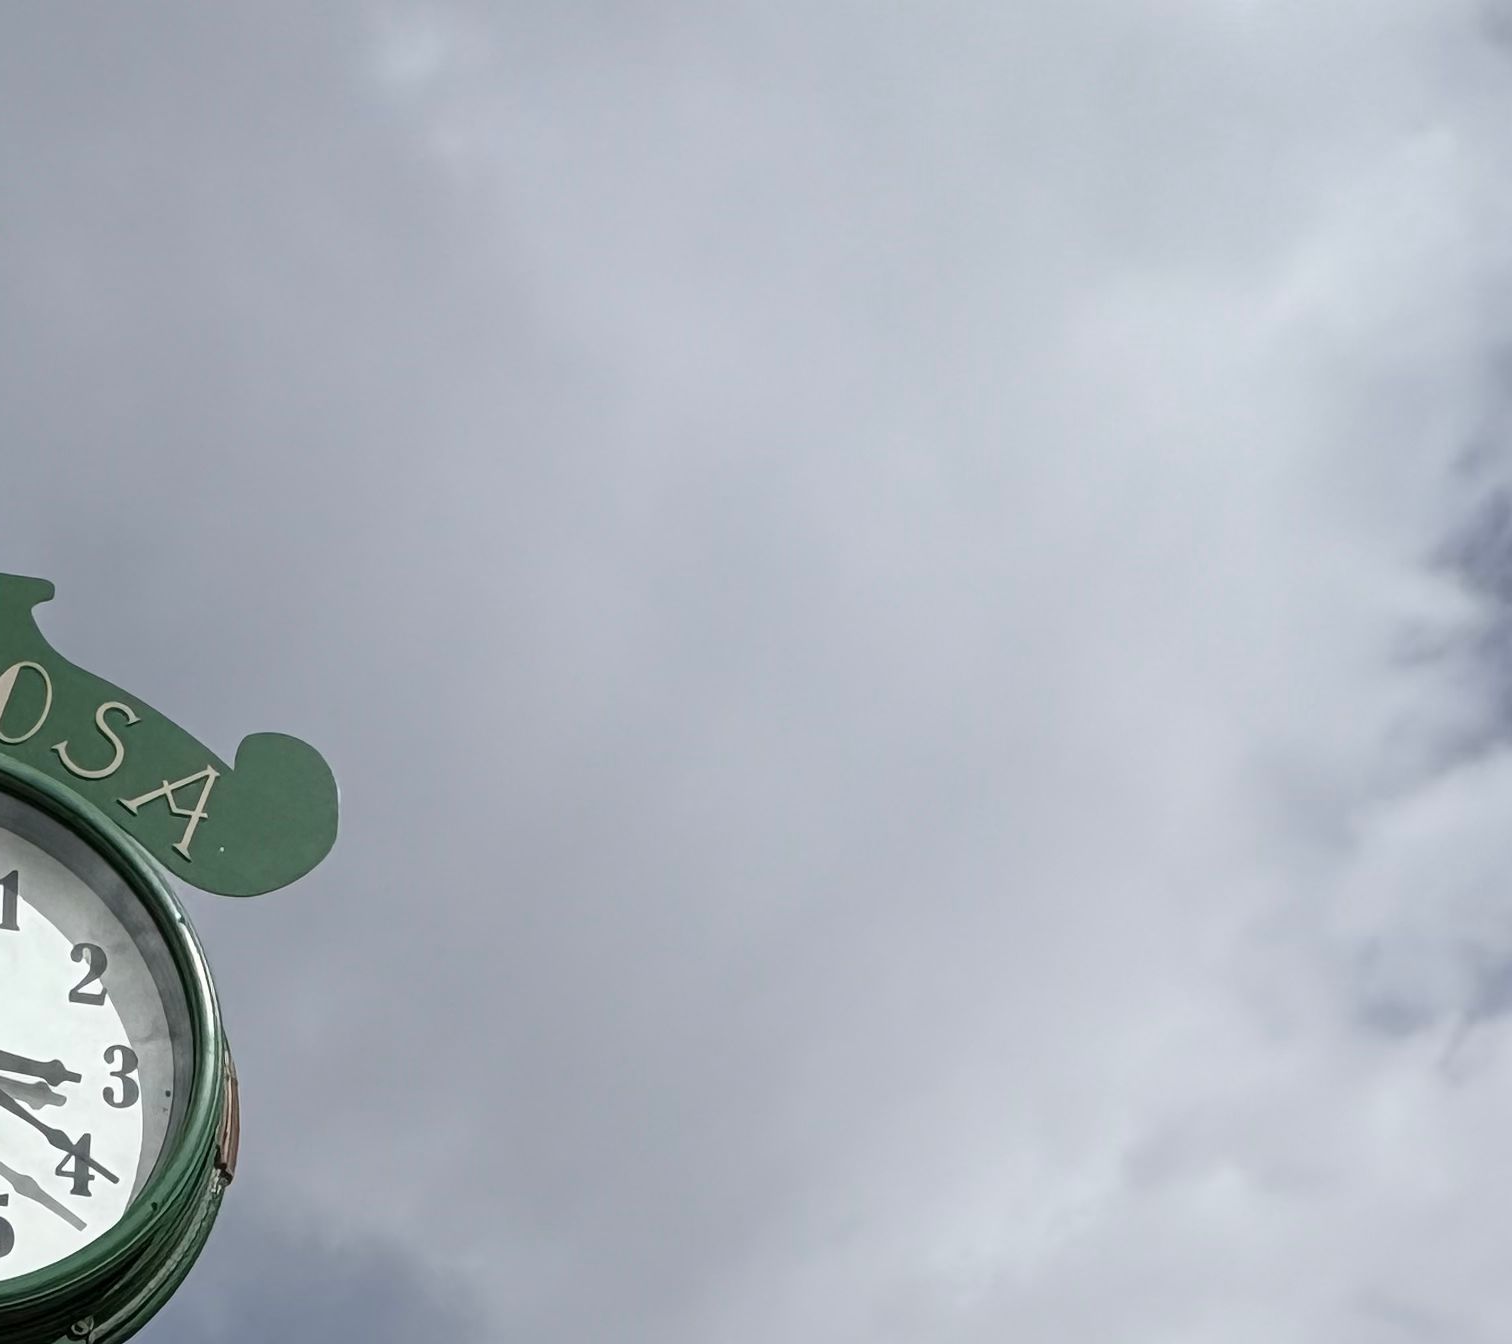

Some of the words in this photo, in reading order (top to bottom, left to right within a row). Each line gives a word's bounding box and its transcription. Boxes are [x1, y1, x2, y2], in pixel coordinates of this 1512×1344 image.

[68, 943, 107, 1007] 2
[103, 1045, 138, 1109] 3
[57, 1133, 96, 1197] 4
